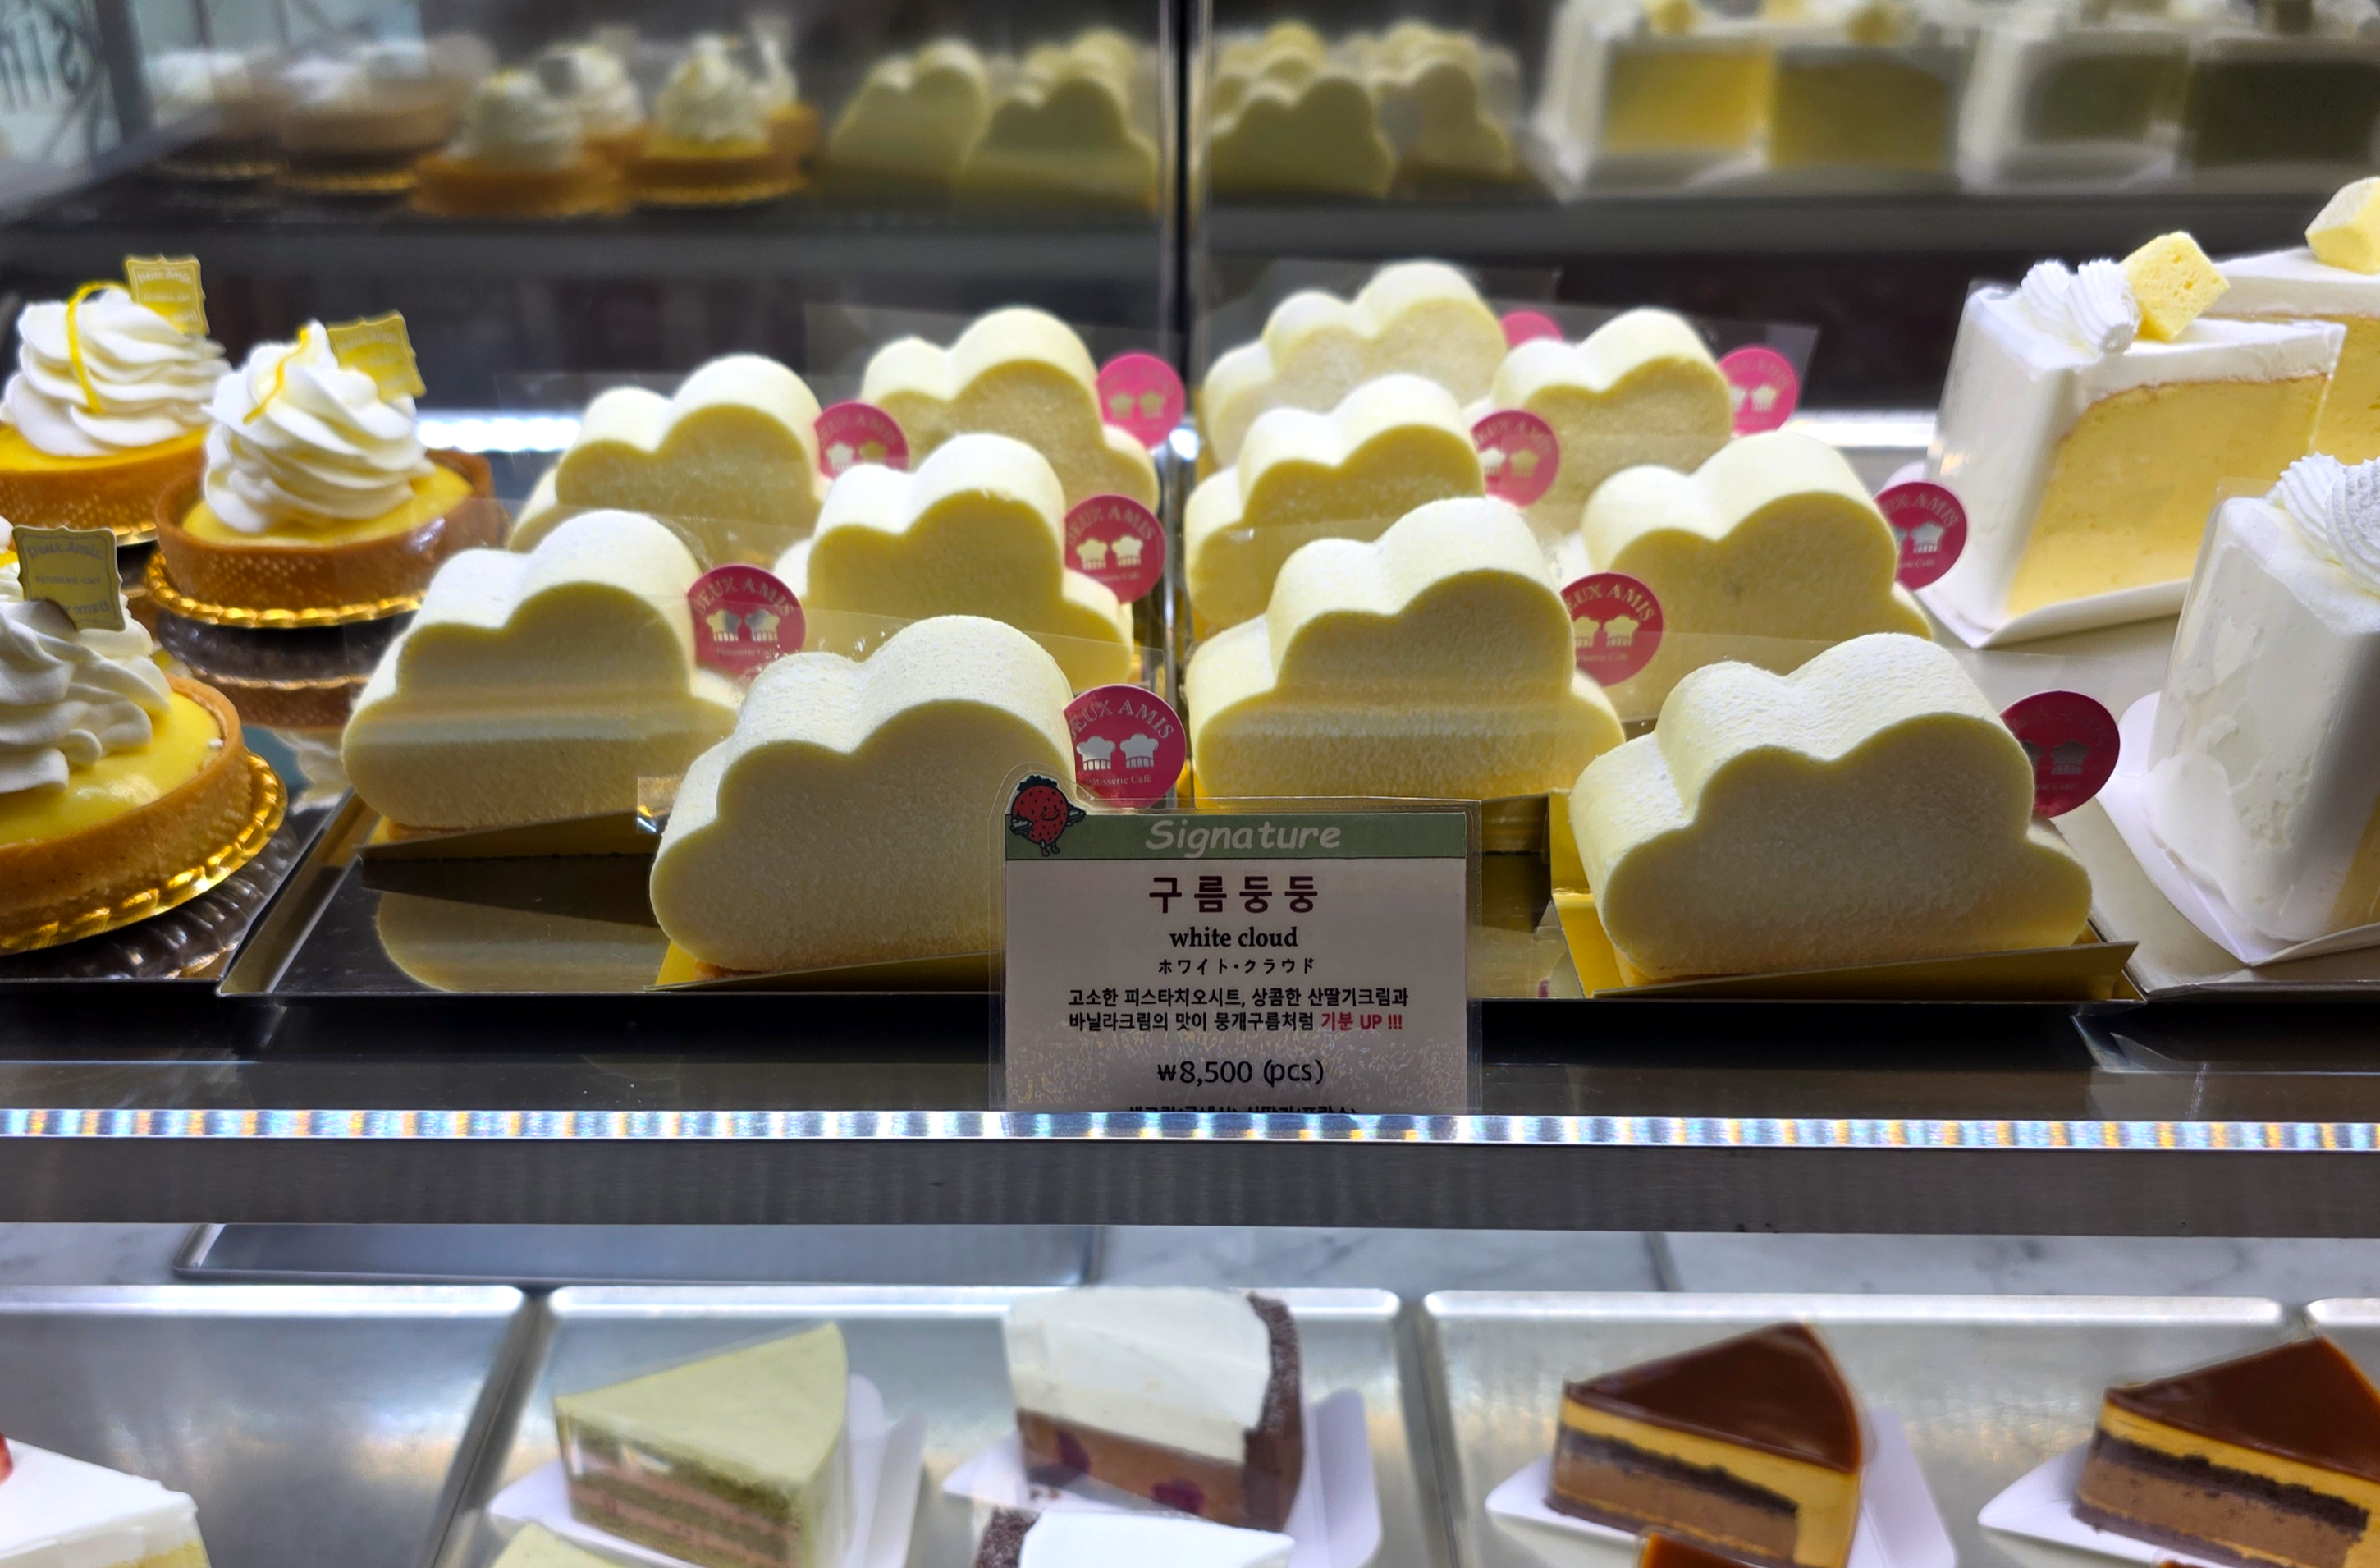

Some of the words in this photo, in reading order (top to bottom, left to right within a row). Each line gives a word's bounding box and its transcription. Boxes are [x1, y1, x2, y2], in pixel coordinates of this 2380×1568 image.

[1563, 583, 1603, 612] EUX
[1606, 583, 1656, 621] AMIS
[1119, 699, 1174, 739] AMIS
[1146, 819, 1342, 858] Signature
[1169, 926, 1231, 947] white
[1238, 926, 1298, 947] cloud
[1158, 957, 1315, 975] ホワイト・クラウド
[1069, 988, 1119, 1007] 고소한
[1124, 988, 1245, 1008] 피스타치오시트,
[1307, 988, 1408, 1007] 산딸기크림과
[1069, 1011, 1168, 1032] 바닐라크림의
[1175, 1011, 1206, 1032] 맛이
[1214, 1011, 1314, 1032] 뭉개구름처럼
[1321, 1011, 1353, 1032] 기분
[1360, 1014, 1382, 1030] UP
[1388, 1014, 1403, 1030] !!!
[1157, 1061, 1252, 1087] ₩8,500
[1263, 1059, 1324, 1088] (pcs)
